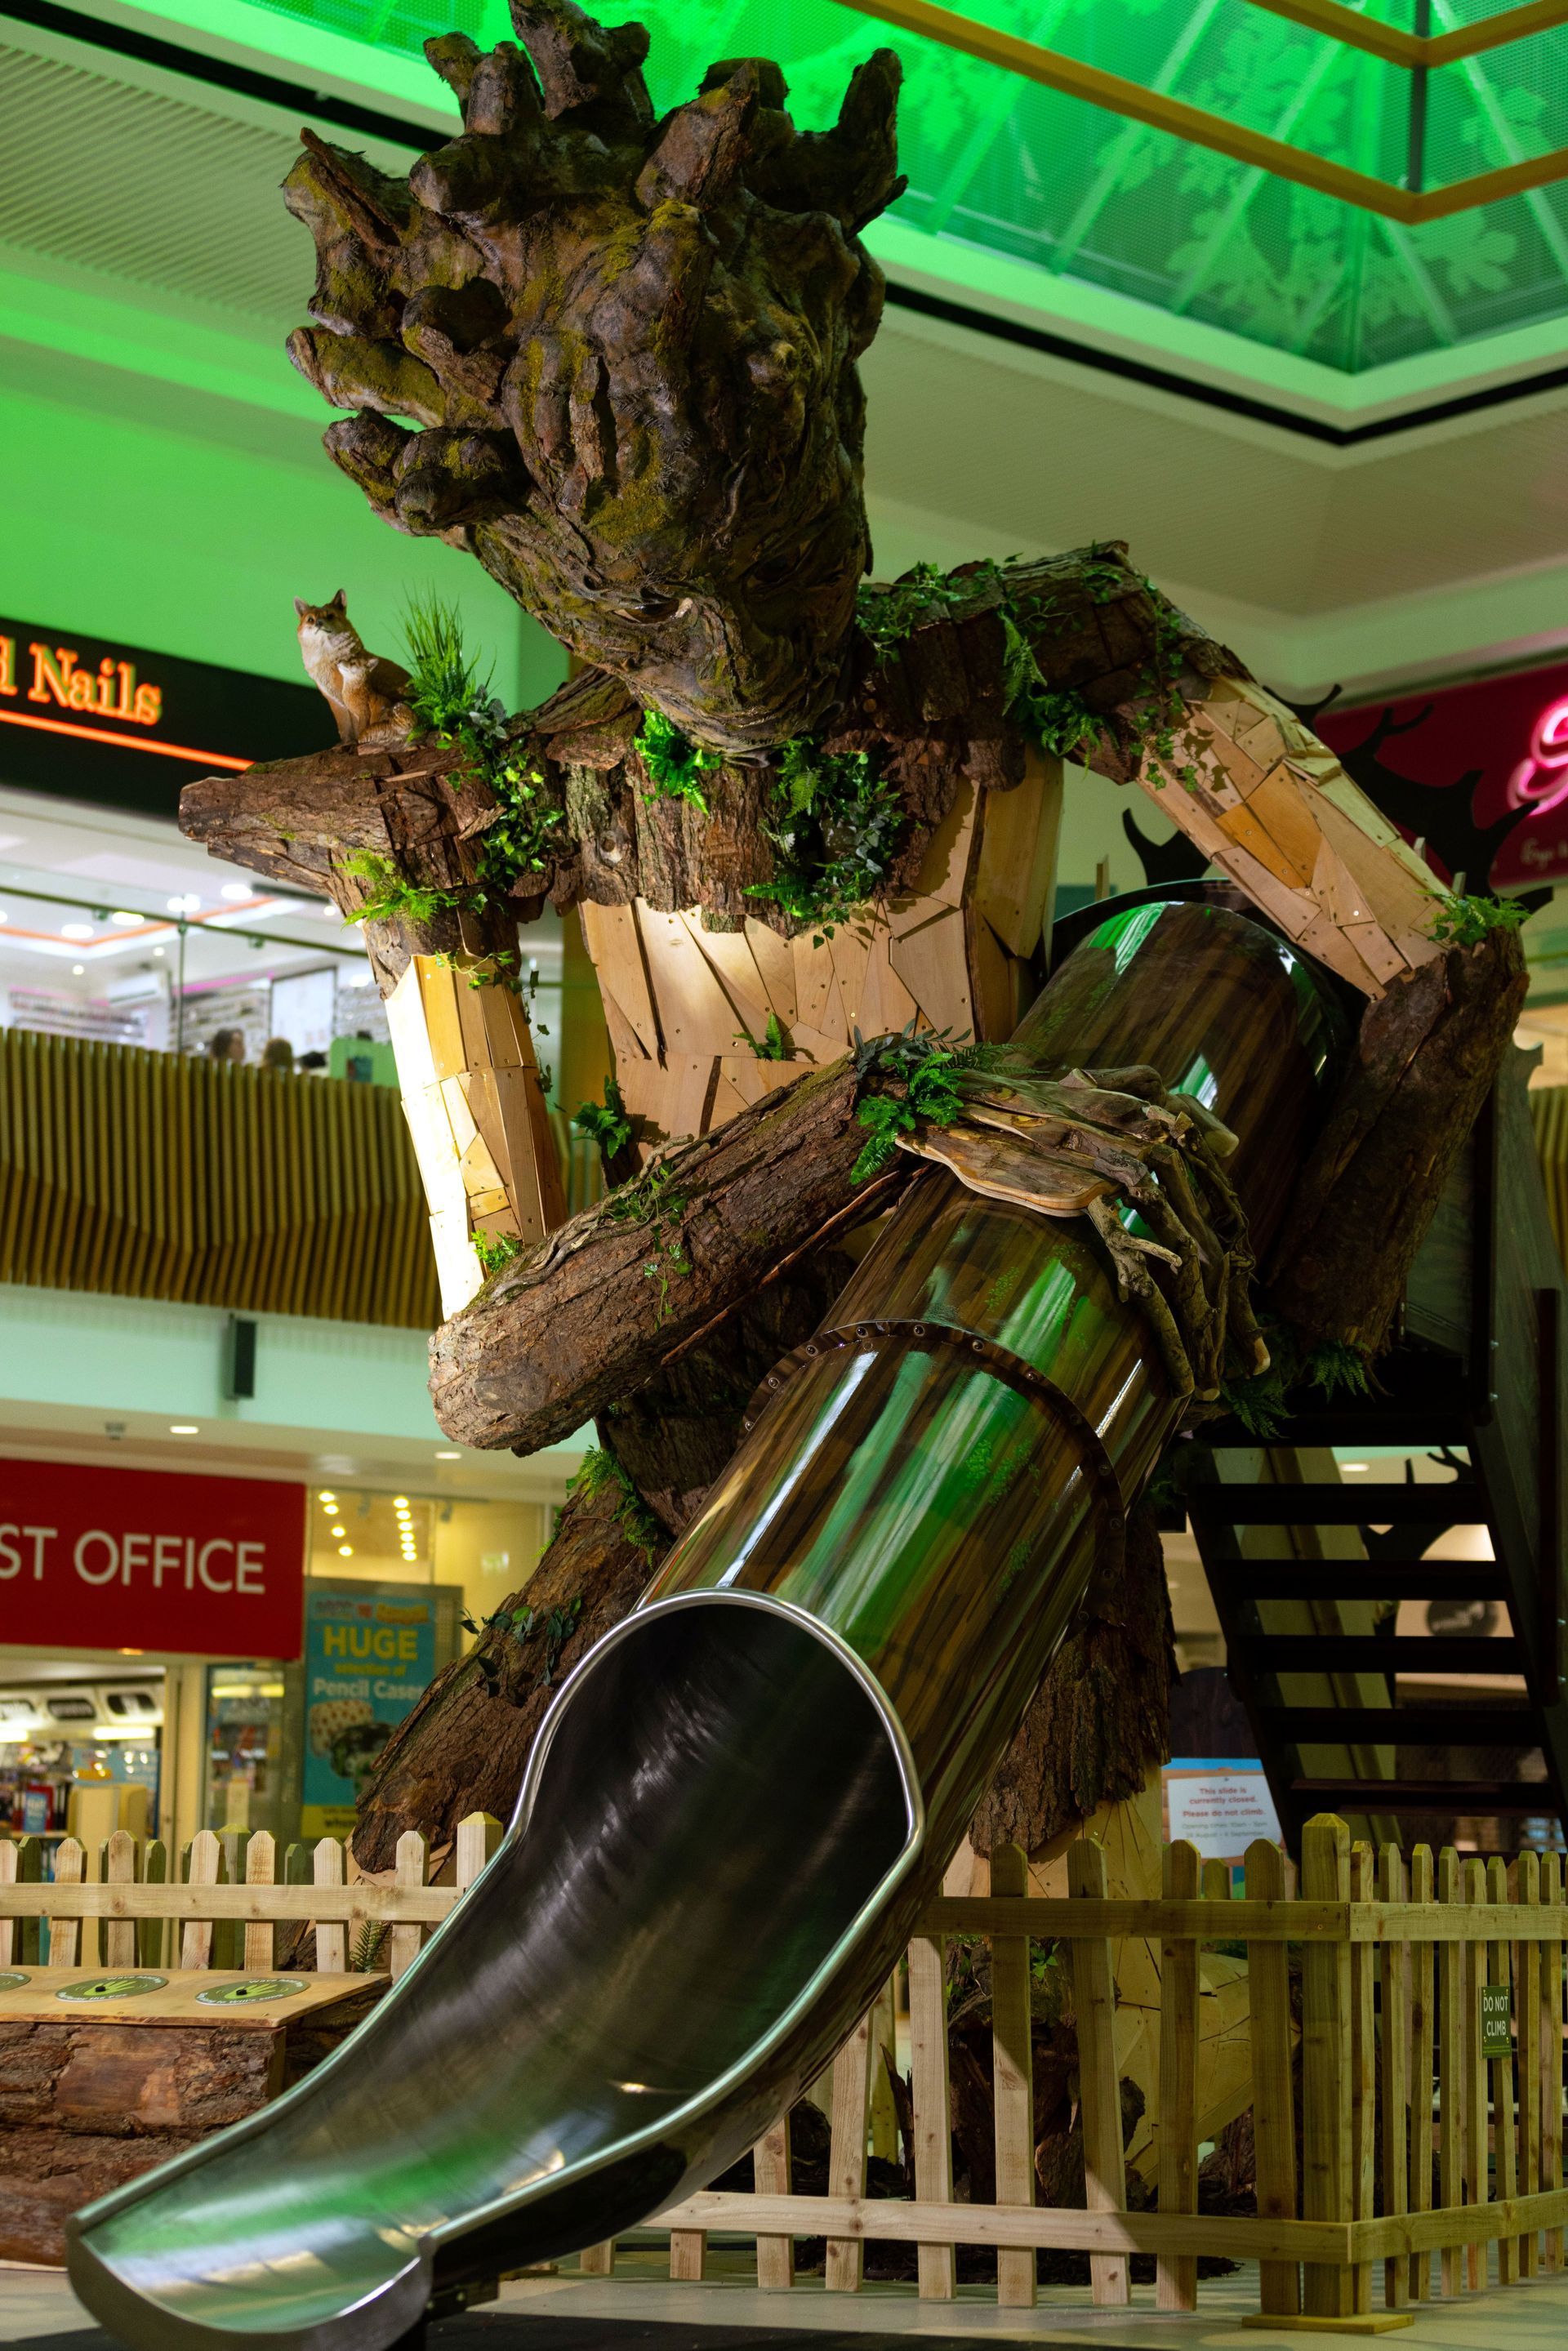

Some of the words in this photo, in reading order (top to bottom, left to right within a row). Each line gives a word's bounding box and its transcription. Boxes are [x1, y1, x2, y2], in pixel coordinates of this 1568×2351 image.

[28, 643, 162, 726] Nails
[74, 1529, 265, 1595] OFFICE
[323, 1624, 419, 1660] HUGE
[313, 1677, 370, 1698] Pencil
[1189, 1797, 1225, 1805] currently
[1483, 1996, 1494, 2012] DO
[1494, 1995, 1508, 2012] NOT
[1486, 2020, 1507, 2037] CLIMB
